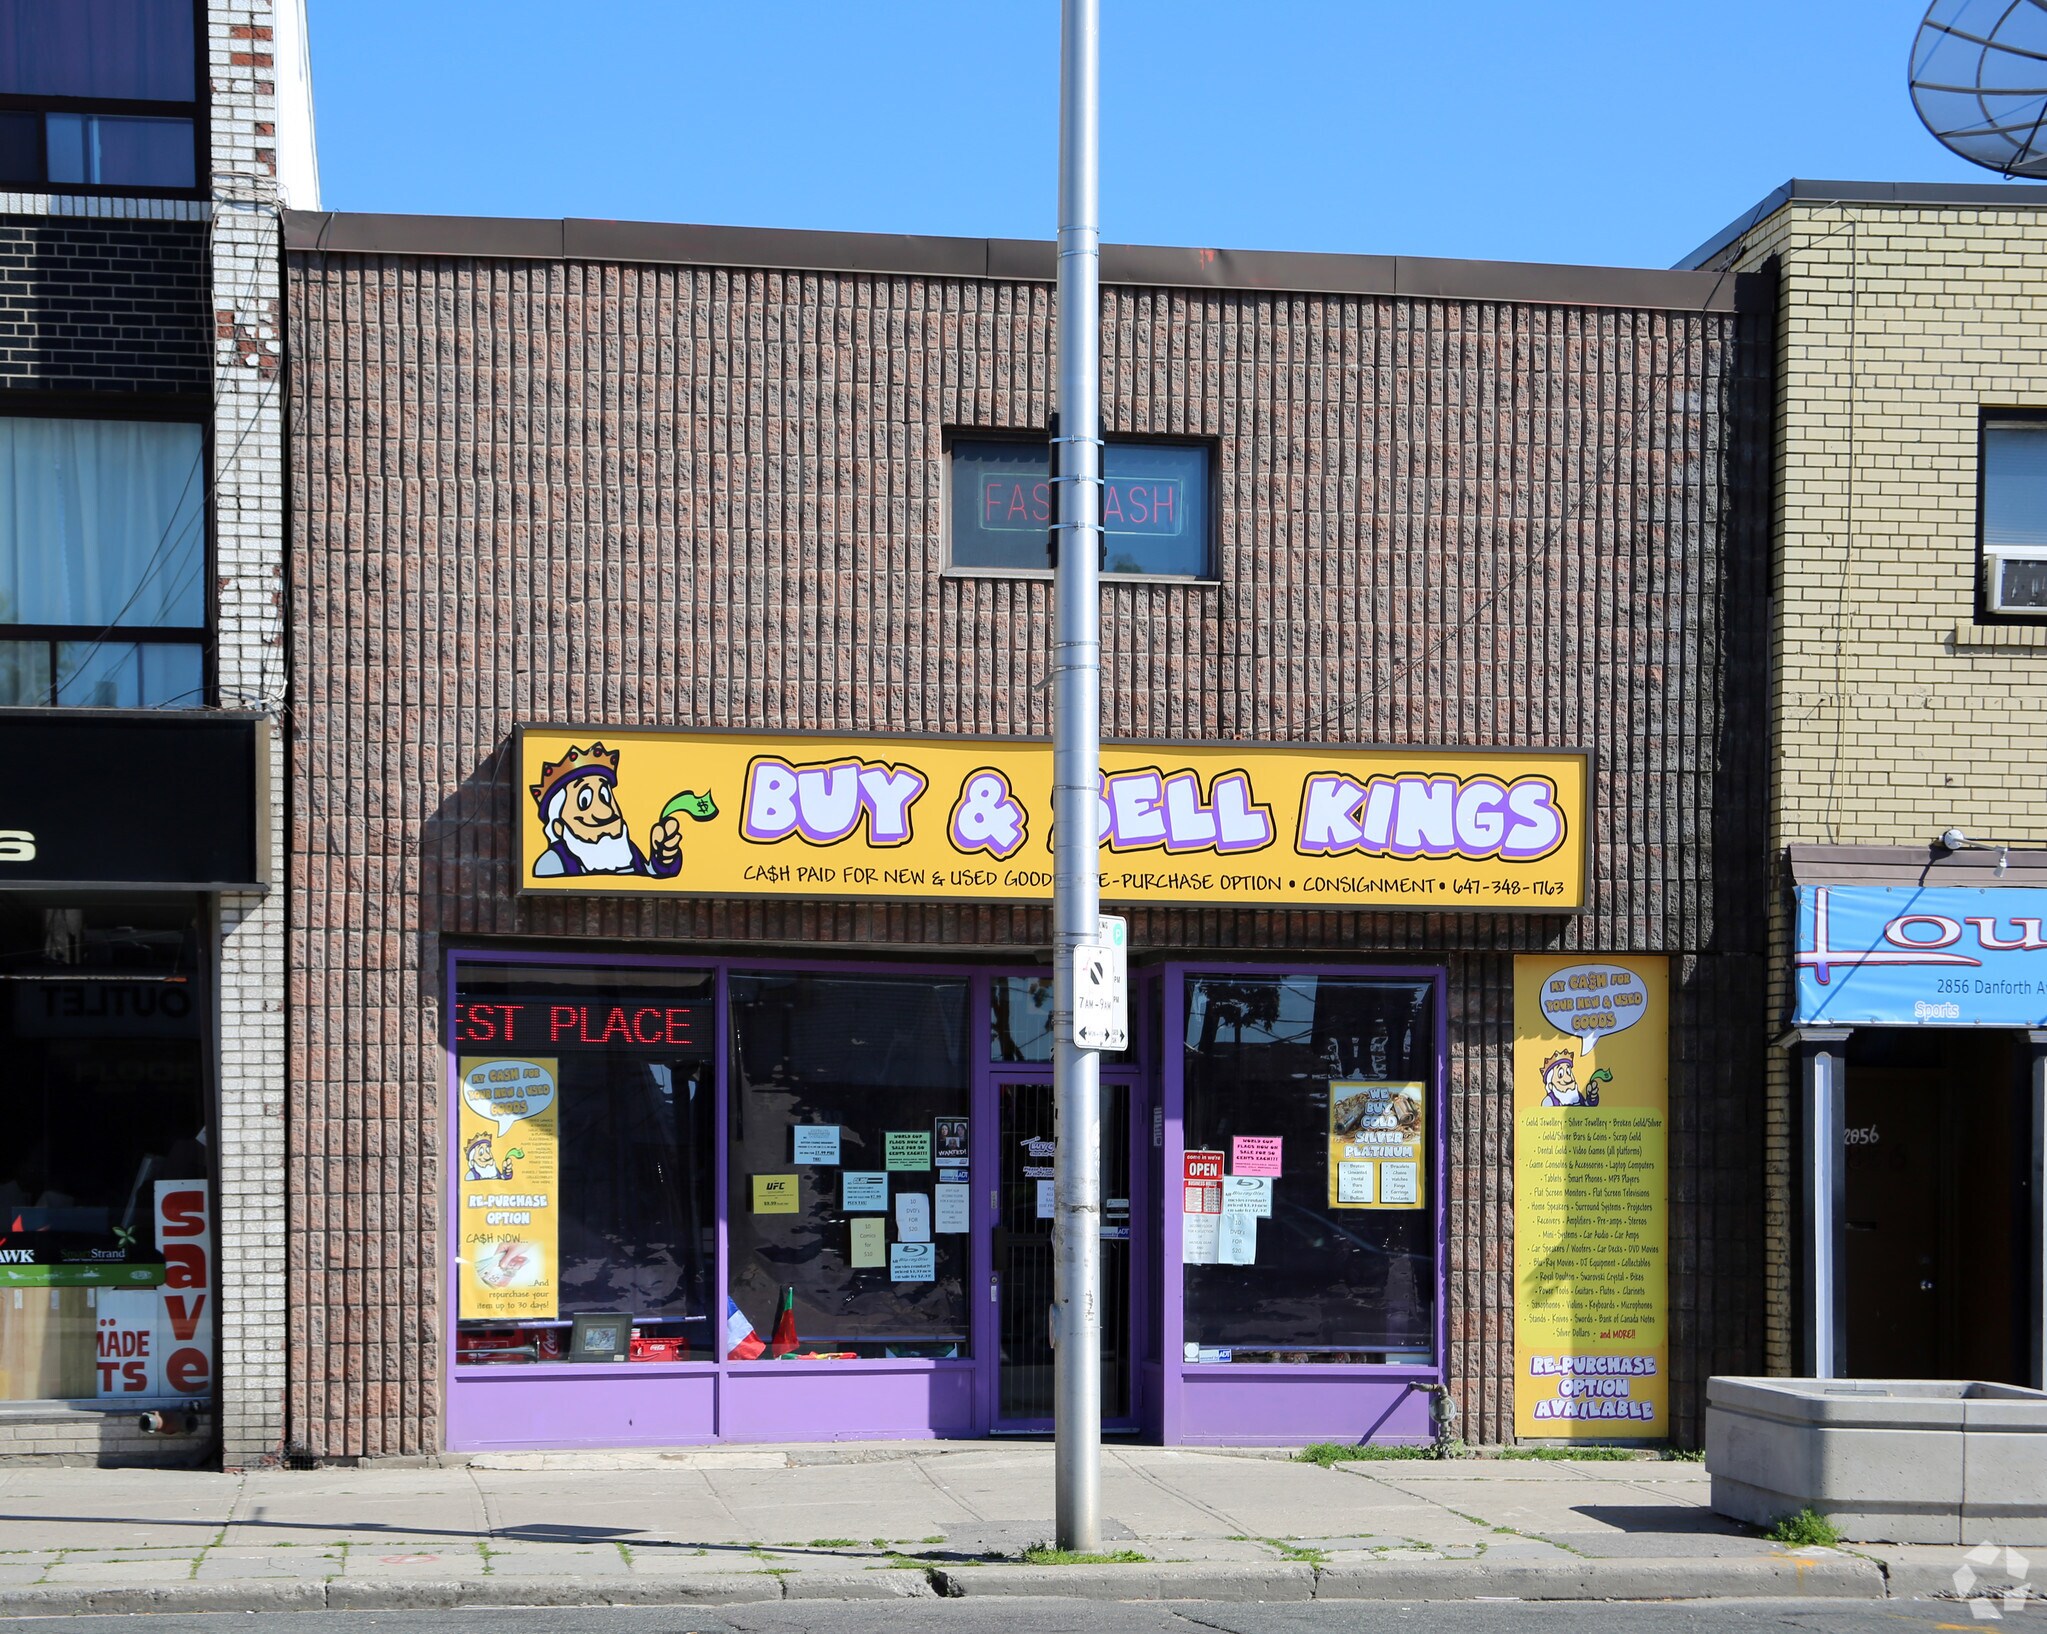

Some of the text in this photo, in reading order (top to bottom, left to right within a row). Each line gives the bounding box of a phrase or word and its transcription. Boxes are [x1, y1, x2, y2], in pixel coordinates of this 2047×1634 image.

[986, 484, 1174, 524] FAS ASH
[742, 759, 926, 844] BUY
[951, 770, 1025, 858] &
[1298, 774, 1565, 861] KINGS
[744, 865, 1565, 896] CA$H PAID FOR NEW & USED GOOD E-PURCHASE OPTION CONSIGNMENT 647-348-1763
[1550, 981, 1565, 992] MY
[1610, 973, 1630, 986] FOR
[1937, 979, 1969, 994] 2856
[1975, 980, 2030, 994] Danforth
[1545, 992, 1642, 1013] YOUR NEW & USED
[1914, 1001, 1959, 1019] Sports
[550, 1006, 692, 1044] PLACE
[1572, 1012, 1616, 1030] GOODS
[523, 1068, 540, 1078] FOR
[468, 1089, 492, 1100] YOUR
[494, 1087, 514, 1099] NEW
[1368, 1088, 1389, 1100] WE
[490, 1100, 528, 1116] GOODS
[1365, 1102, 1393, 1114] BUY
[1361, 1115, 1398, 1129] GOLD
[1568, 1118, 1582, 1126] Silver
[1585, 1118, 1607, 1129] Jewellery
[1613, 1118, 1631, 1127] Broken
[1633, 1118, 1662, 1128] Gold/Silver
[1355, 1131, 1404, 1144] SILVER
[1344, 1145, 1413, 1158] PLATINUM
[1189, 1162, 1217, 1176] OPEN
[1575, 1160, 1603, 1168] Accessories
[1610, 1160, 1626, 1171] Laptop
[1628, 1160, 1654, 1171] Computers
[766, 1182, 785, 1190] UFC
[1544, 1174, 1562, 1182] Tablets
[1568, 1174, 1583, 1183] Smart
[1585, 1174, 1602, 1183] Phones
[1622, 1174, 1640, 1186] Players
[1534, 1187, 1544, 1197] Flat
[1545, 1188, 1562, 1196] Screen
[1593, 1188, 1602, 1197] Flat
[1604, 1188, 1621, 1197] Screen
[1623, 1188, 1650, 1197] Televisions
[469, 1194, 548, 1208] RE-PURCHASE
[1531, 1202, 1652, 1213] Home Speakers Surround Systems Projectors
[486, 1211, 530, 1225] OPTION
[1537, 1217, 1560, 1225] Receivers
[1567, 1216, 1592, 1227] Amplifiers
[1628, 1216, 1647, 1225] Stereos
[1557, 1259, 1574, 1267] Movies
[1580, 1258, 1588, 1267] DJ
[1590, 1258, 1616, 1270] Equipment
[1622, 1258, 1650, 1267] Collectables
[1540, 1272, 1644, 1284] Royal Doulton Swarovski Crystal Bikes
[1538, 1285, 1645, 1295] Power Tools Guitars Flutes Clarinets
[1566, 1300, 1583, 1309] Violins
[1589, 1300, 1615, 1311] Keyboards
[1621, 1300, 1653, 1311] Microphones
[1529, 1314, 1655, 1323] Stands Knives Swords Bank of Canada Notes
[1556, 1328, 1636, 1339] Silver Dollars and MORE!!
[1530, 1356, 1657, 1376] RE-PURCHASE
[1558, 1377, 1629, 1399] OPTION
[1533, 1398, 1655, 1422] AVAILABLE
